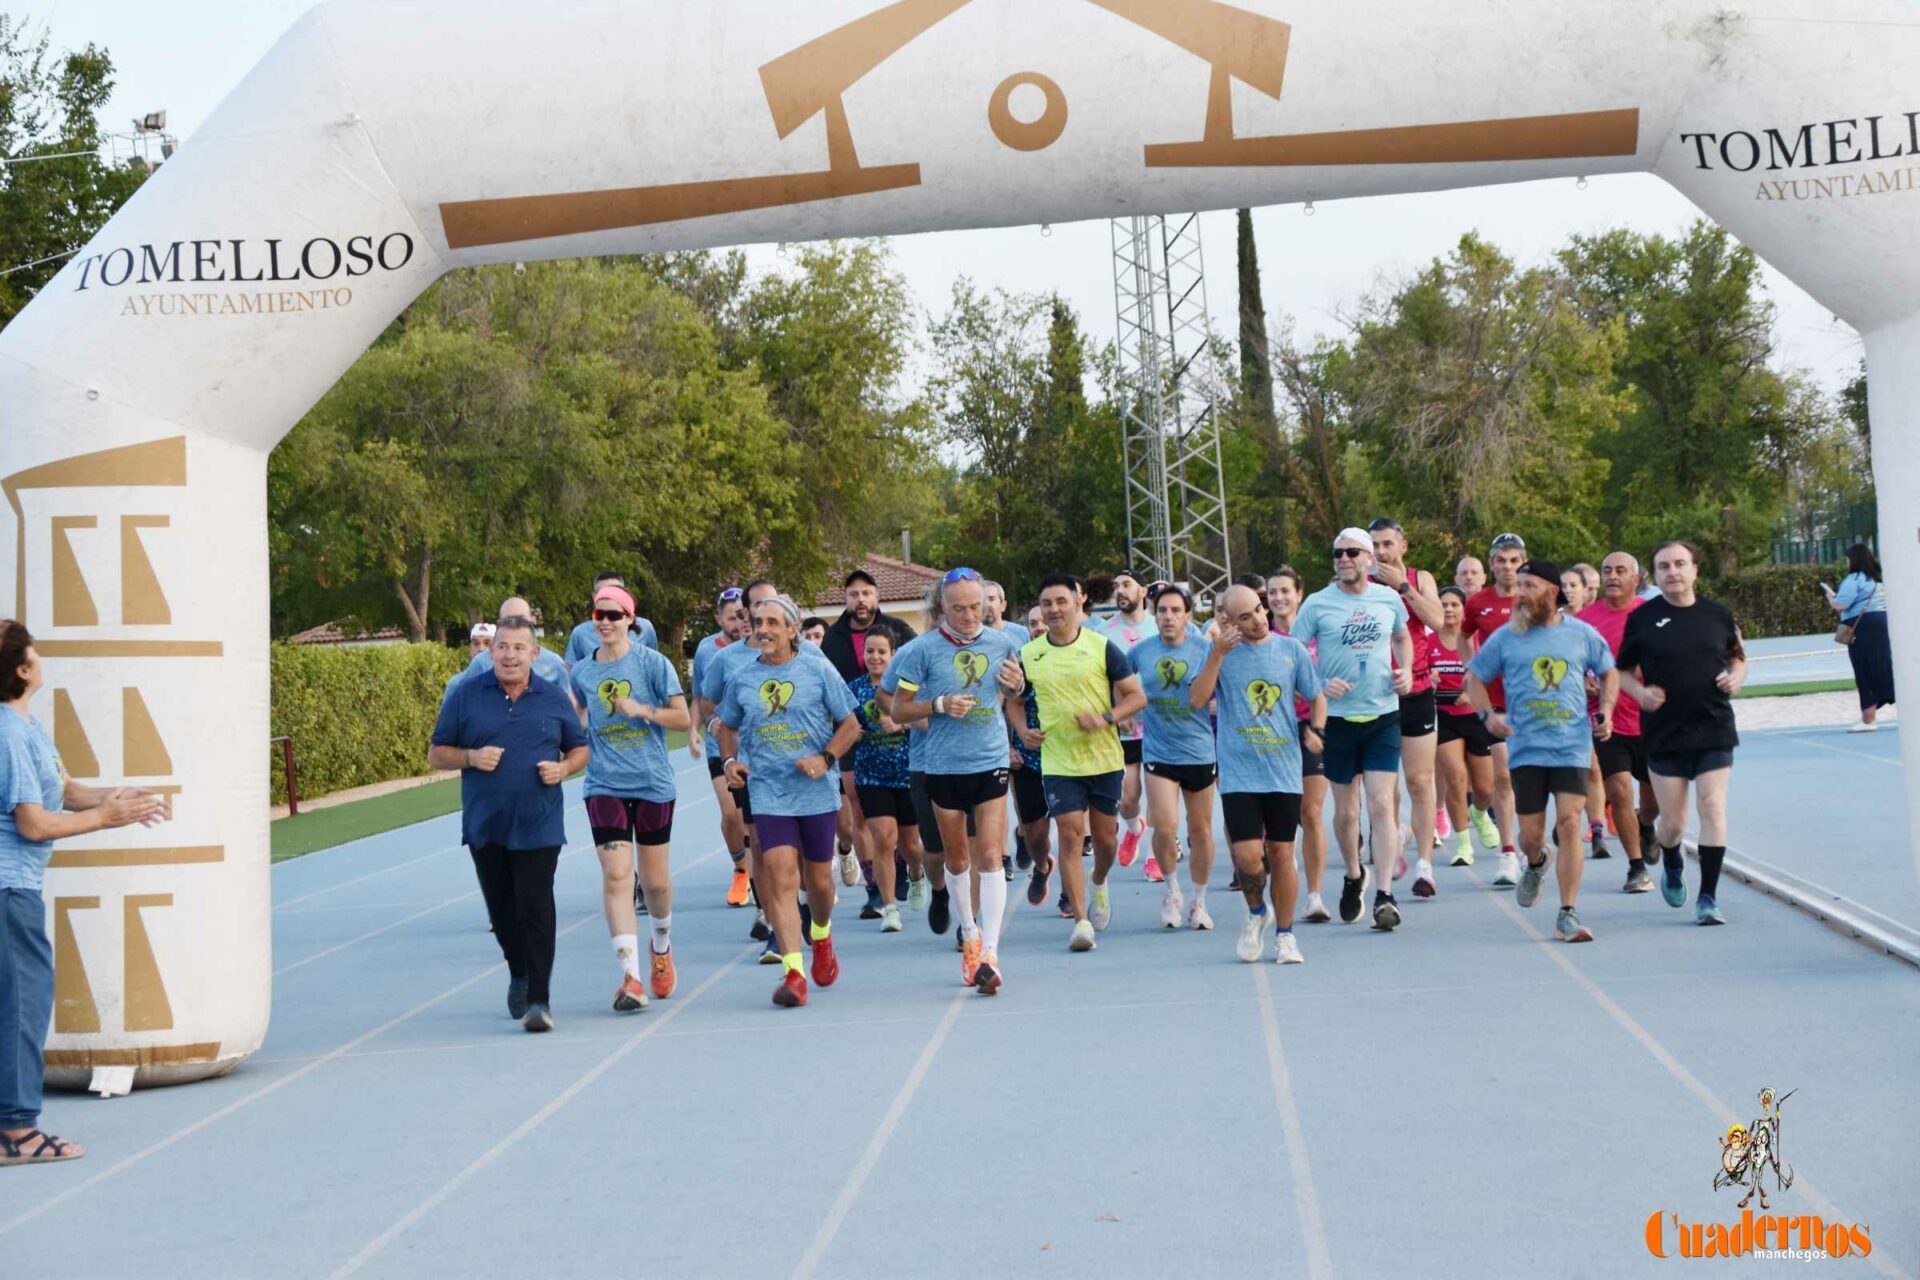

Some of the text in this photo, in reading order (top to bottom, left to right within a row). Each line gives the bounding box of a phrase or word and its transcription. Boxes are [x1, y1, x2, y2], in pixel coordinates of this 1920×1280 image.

[1756, 167, 1920, 200] AYUNTAMI
[73, 233, 413, 291] TOMELLOSO
[120, 287, 352, 316] AYUNTAMIENTO
[1341, 623, 1381, 640] TOME
